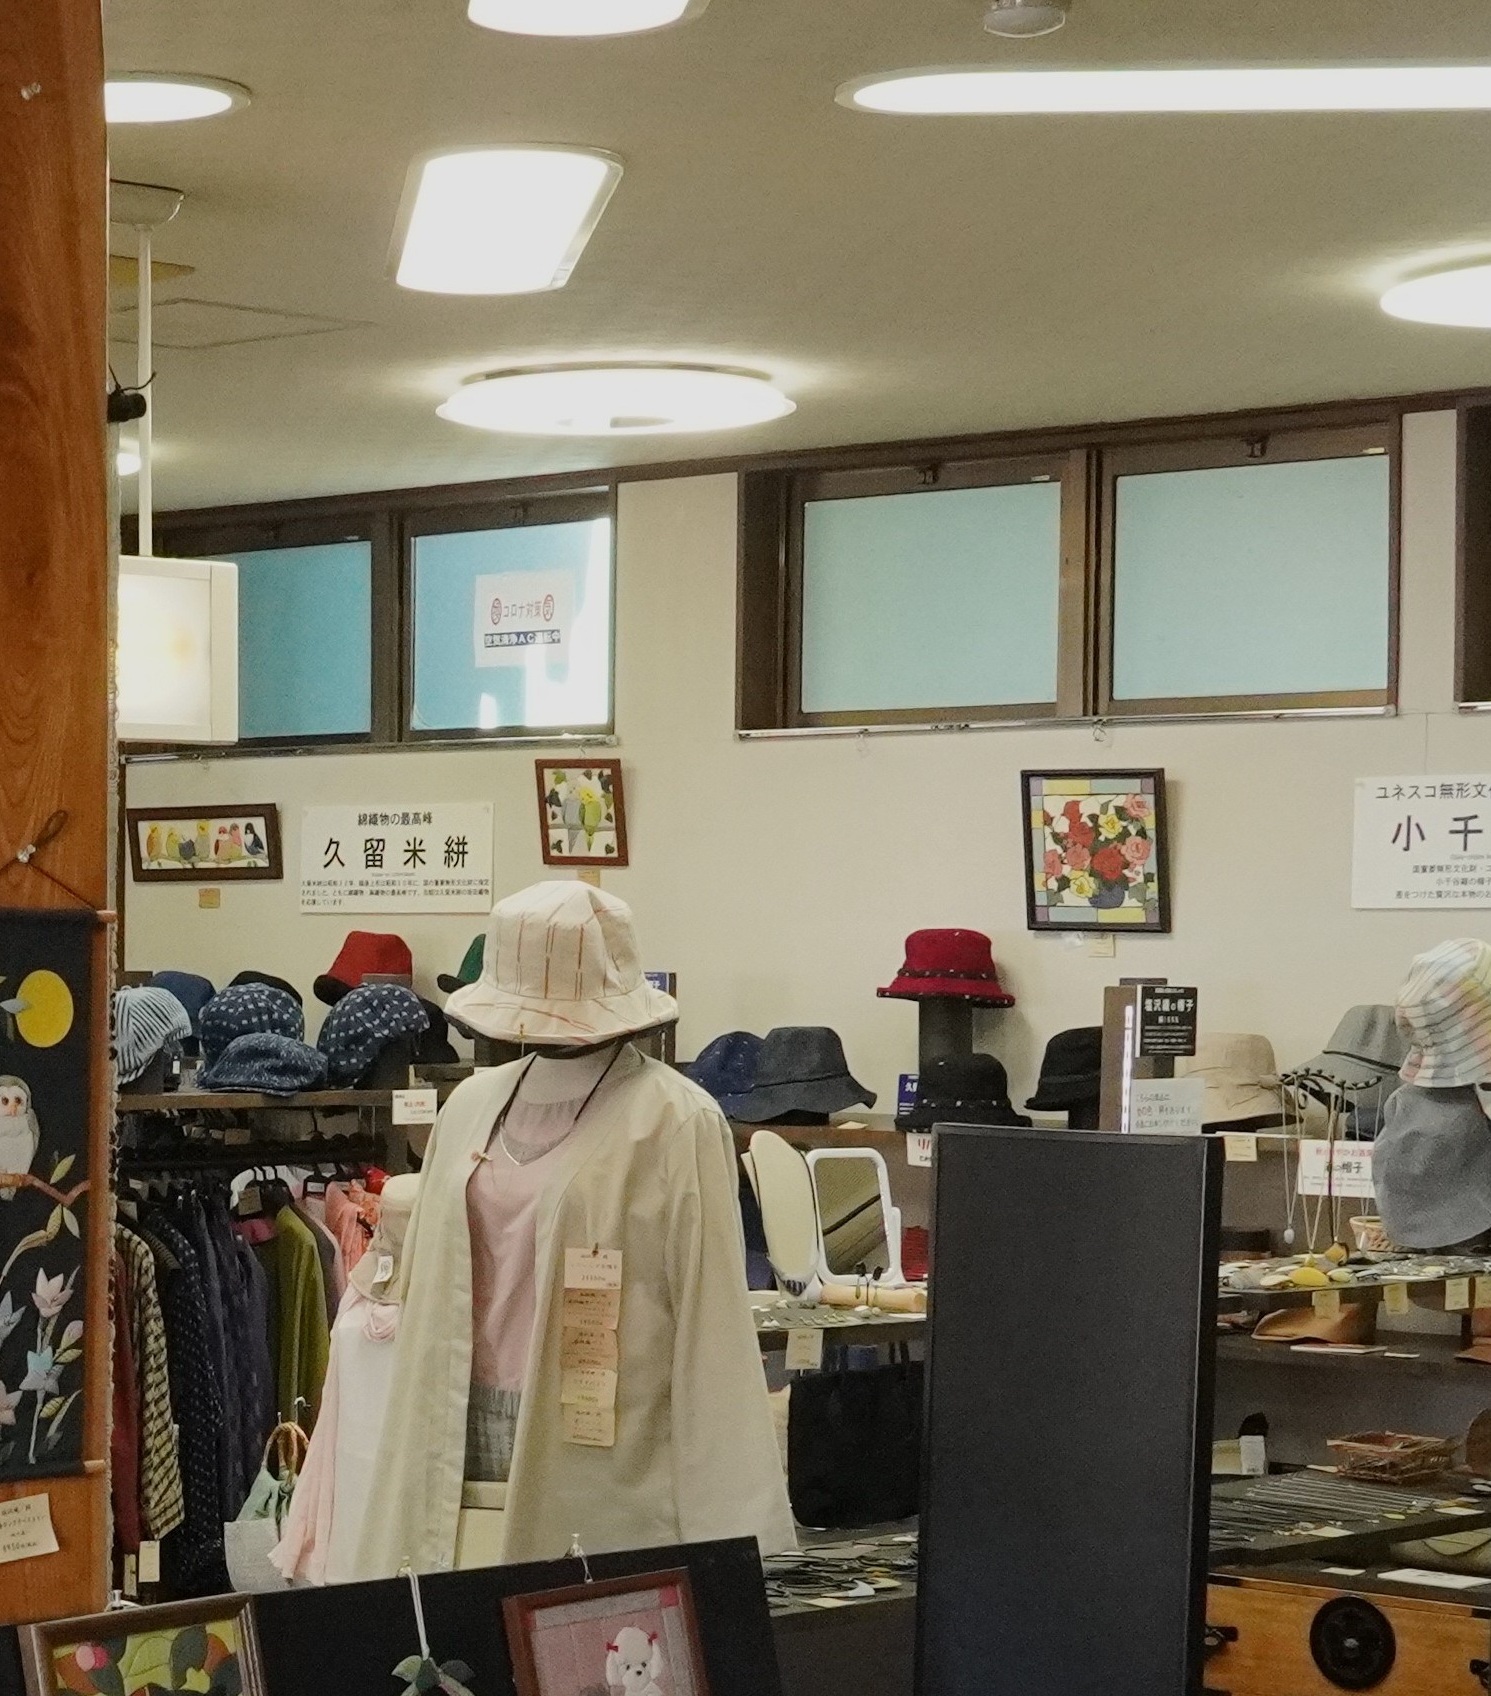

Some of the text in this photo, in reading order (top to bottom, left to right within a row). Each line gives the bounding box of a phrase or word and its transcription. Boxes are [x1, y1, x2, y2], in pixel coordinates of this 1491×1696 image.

[357, 811, 433, 826] 綿織物の最高峰
[323, 836, 469, 869] 久留米絣
